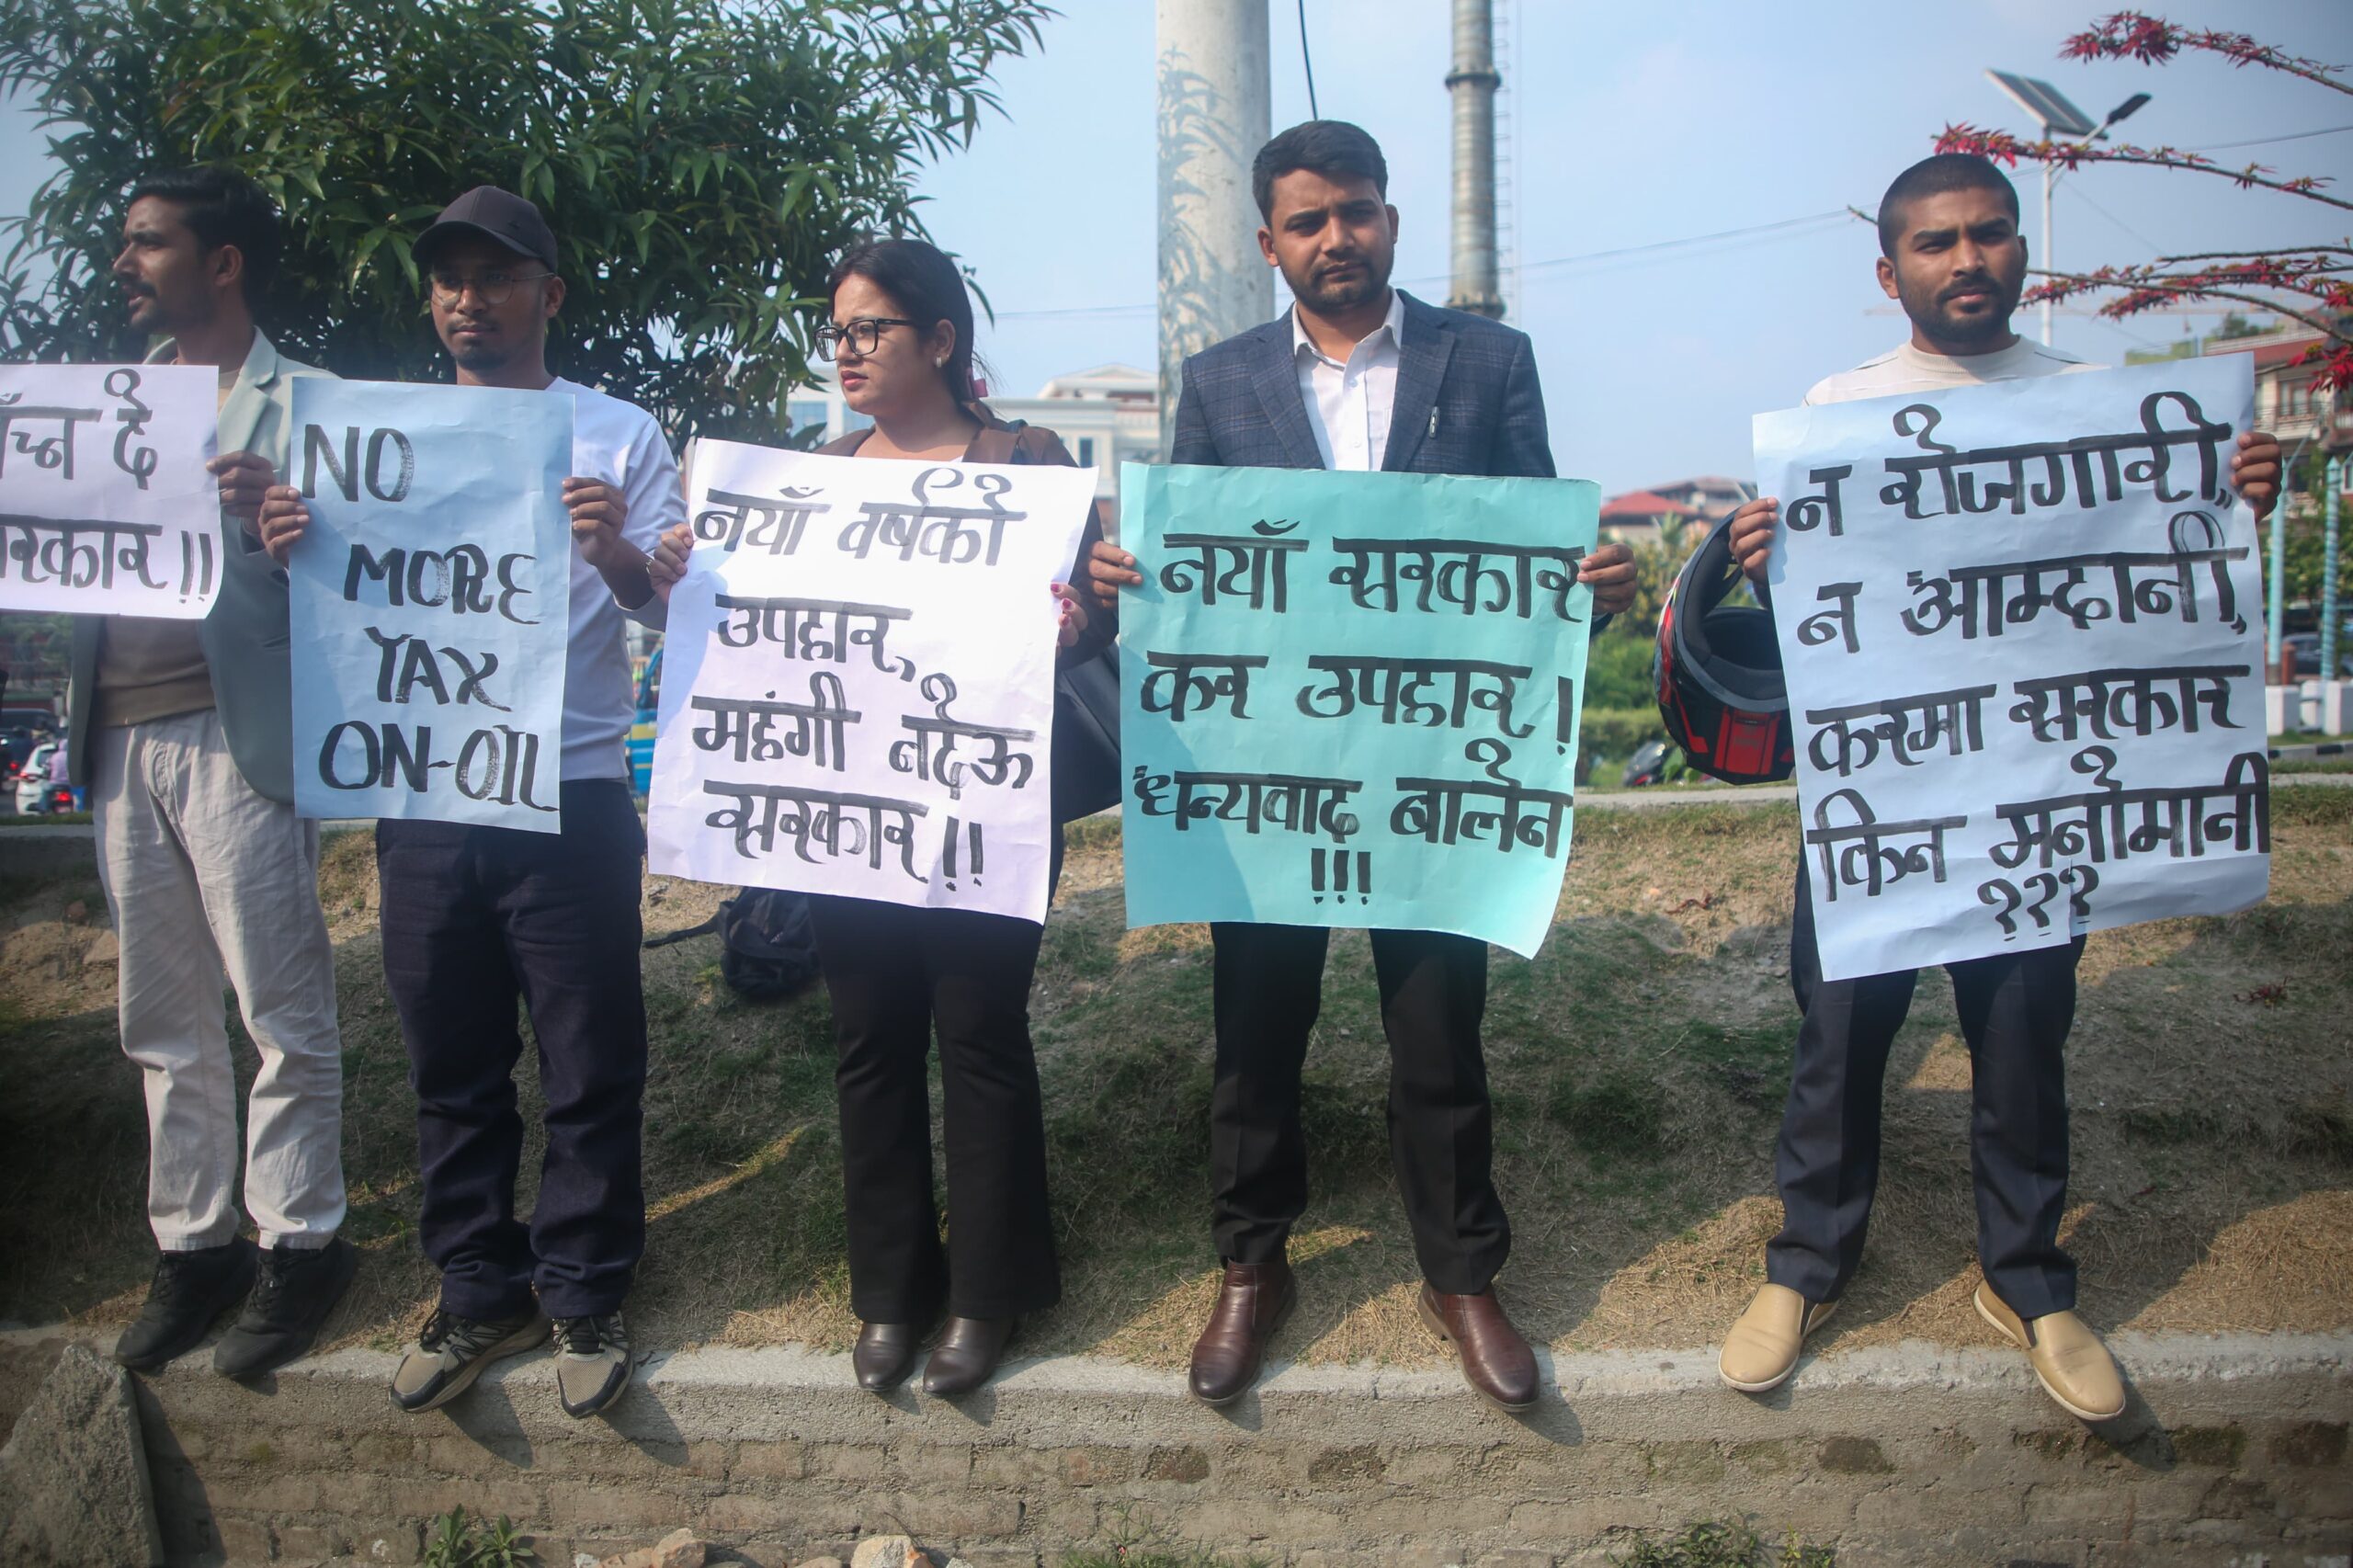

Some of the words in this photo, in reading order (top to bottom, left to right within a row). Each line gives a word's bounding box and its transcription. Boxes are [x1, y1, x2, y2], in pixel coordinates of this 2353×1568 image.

[104, 368, 158, 490] दे
[301, 424, 415, 503] NO
[694, 485, 832, 555] नयाँ
[836, 467, 1028, 566] वर्षको
[1785, 463, 1853, 537] न
[344, 543, 540, 624] MORE
[1160, 518, 1310, 614] नयाँ
[1328, 536, 1586, 623] सरकार
[1797, 581, 1864, 654] न
[363, 626, 512, 712] TAX
[1141, 650, 1269, 722] कर
[318, 721, 560, 812] ON-OIL
[1805, 683, 1997, 778] करमा
[2008, 665, 2252, 743] सरकार
[1131, 765, 1363, 844] धन्यवाद
[1390, 737, 1574, 859] बालेन
[1805, 788, 1968, 903] किन
[1987, 744, 2271, 869] मनोमानी
